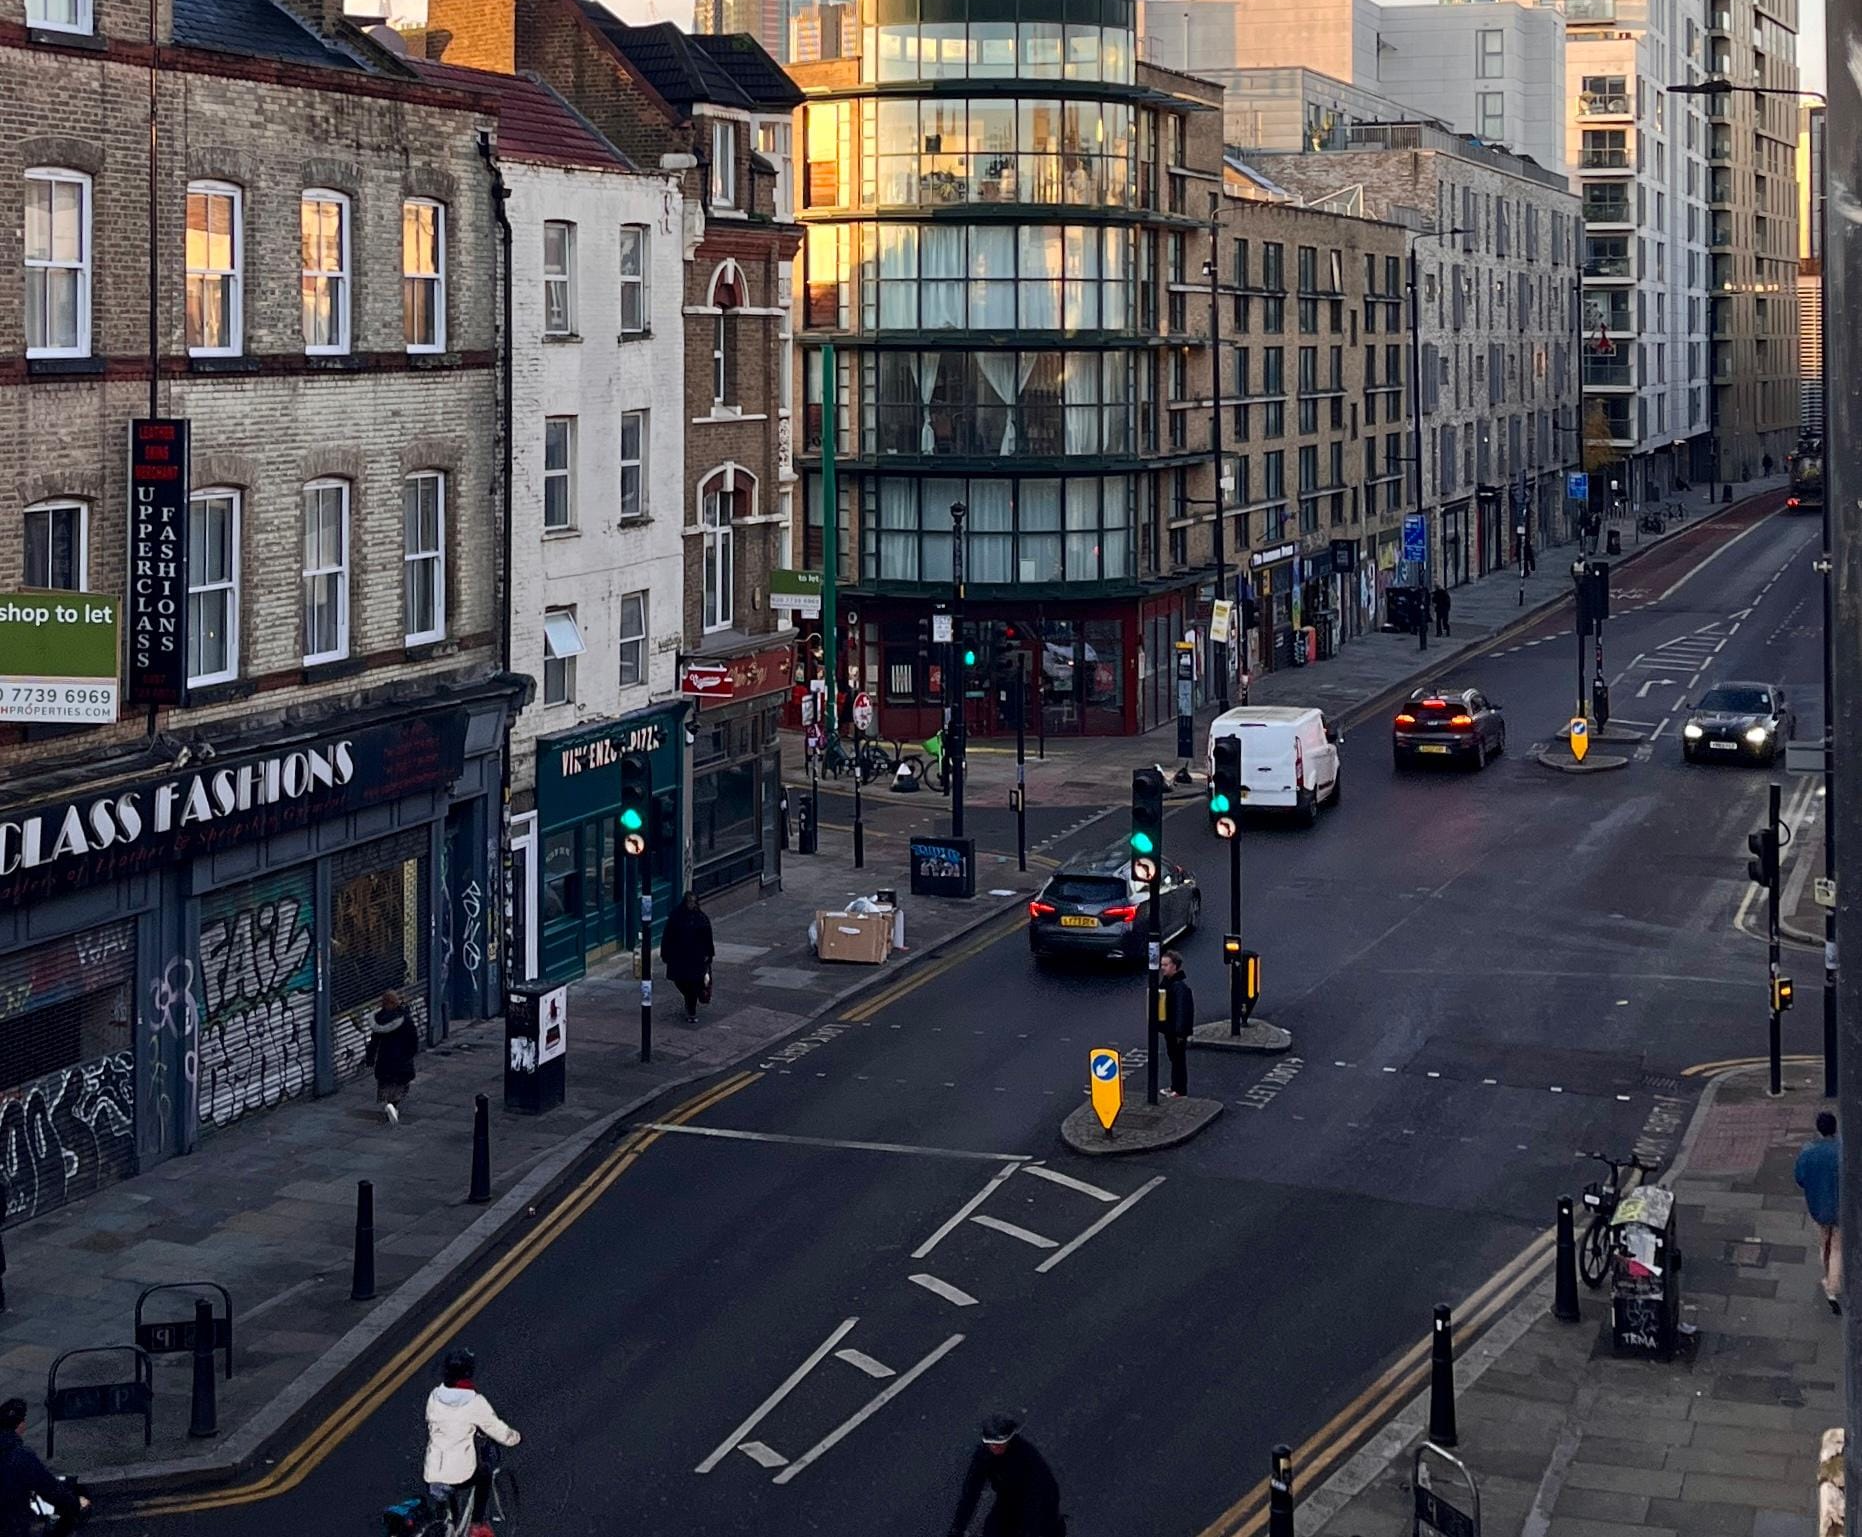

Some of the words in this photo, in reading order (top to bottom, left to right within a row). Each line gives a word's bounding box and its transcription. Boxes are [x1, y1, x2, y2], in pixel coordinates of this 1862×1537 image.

[0, 602, 49, 626] shop
[55, 605, 78, 623] to
[85, 604, 113, 623] let
[136, 486, 155, 668] UPPERCLASS
[157, 506, 177, 652] FASHIONS
[12, 688, 57, 703] 7739
[65, 689, 111, 704] 6969
[154, 740, 354, 833] FASHIONS
